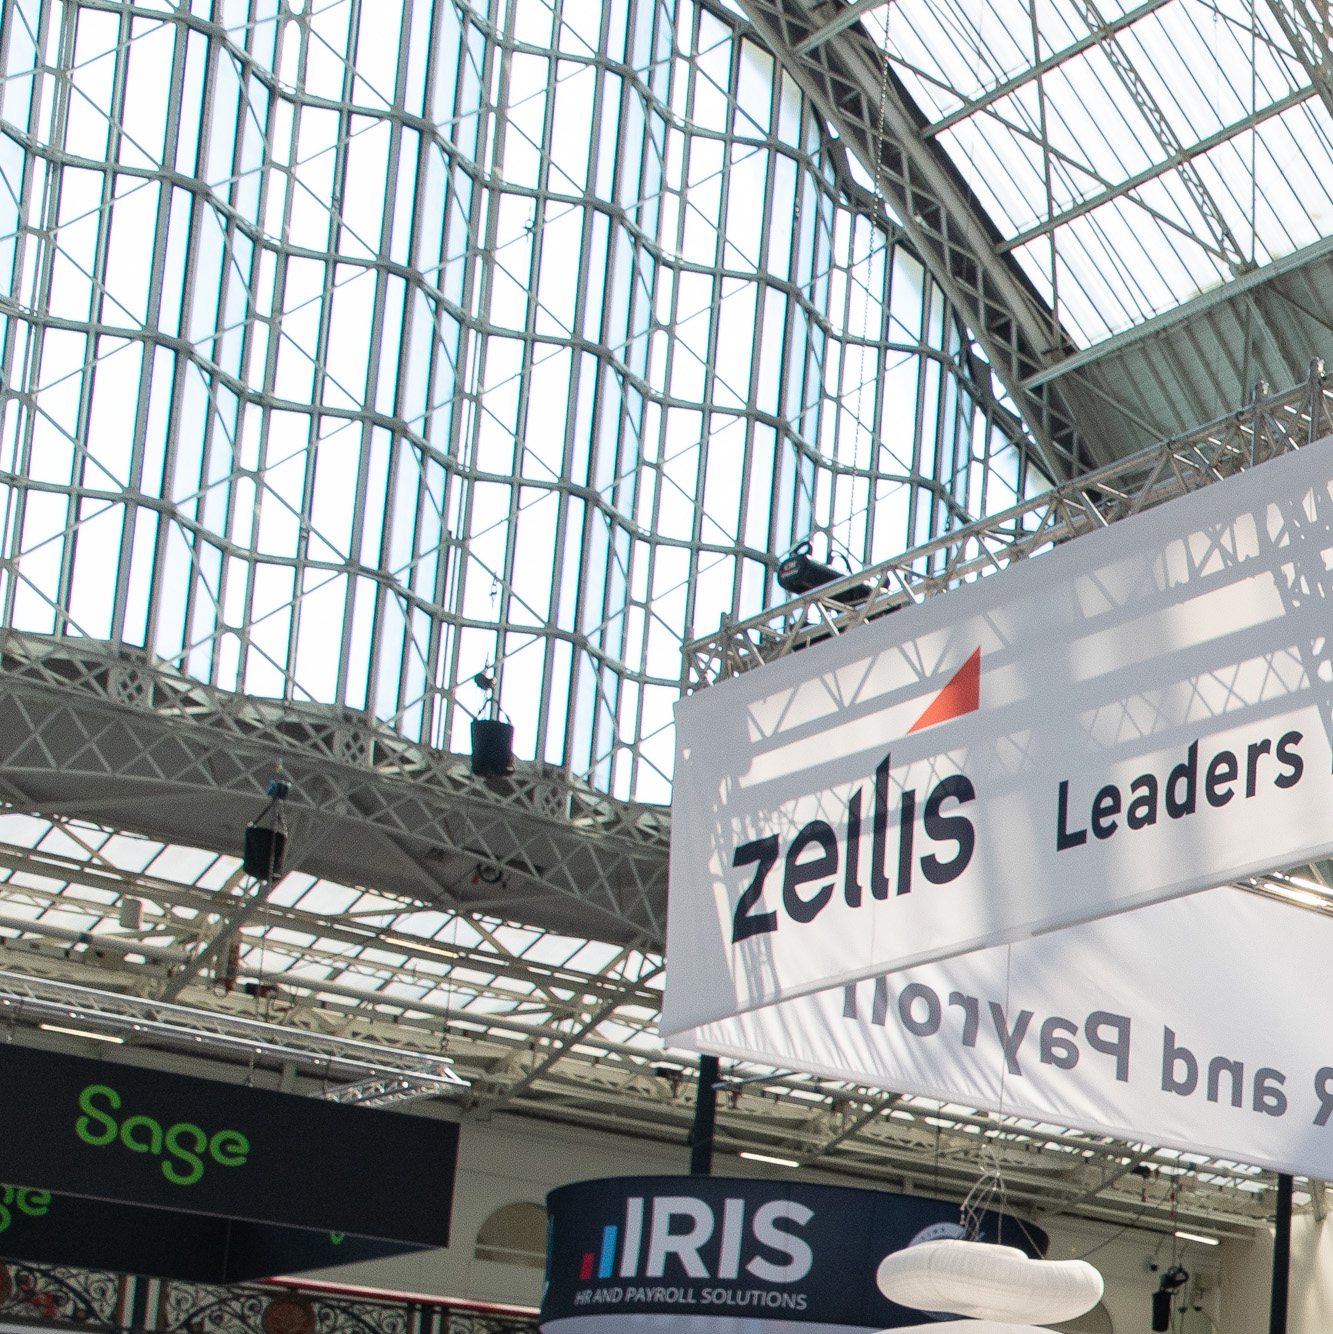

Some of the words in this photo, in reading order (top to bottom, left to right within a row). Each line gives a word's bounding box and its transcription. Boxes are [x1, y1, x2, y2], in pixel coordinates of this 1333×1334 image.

[730, 752, 977, 944] zellis
[1055, 730, 1305, 852] Leaders
[75, 1083, 250, 1186] Sage
[619, 1195, 816, 1284] IRIS
[592, 1287, 624, 1304] AND
[624, 1286, 698, 1305] PAYROLL
[701, 1287, 808, 1311] SOLUTIONS
